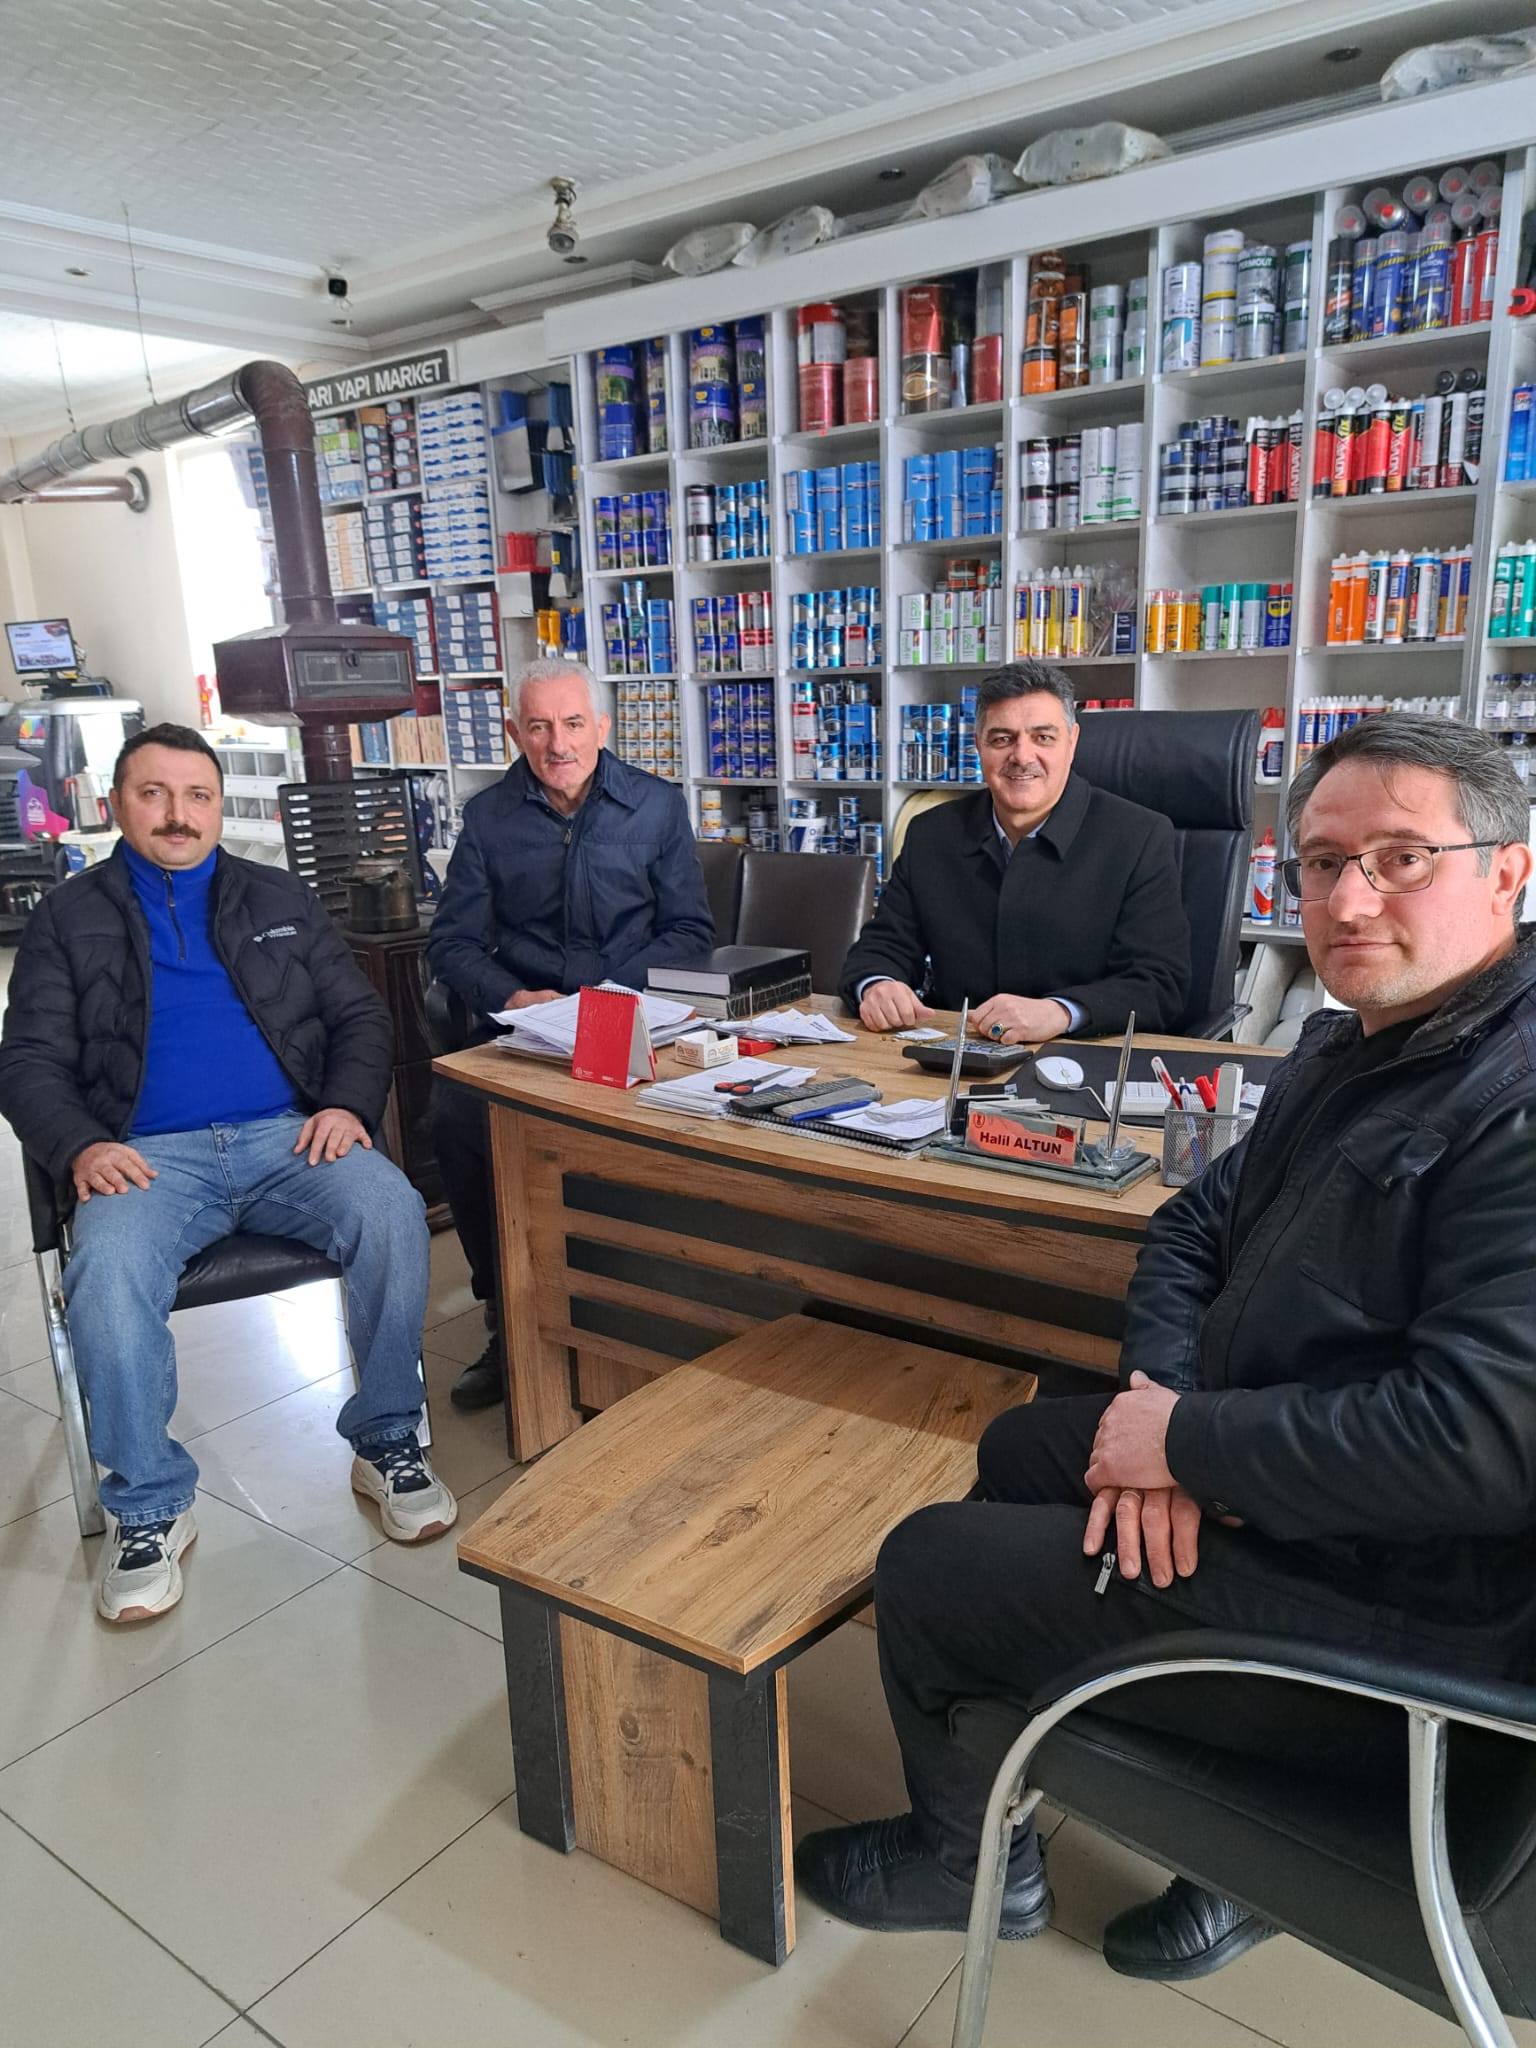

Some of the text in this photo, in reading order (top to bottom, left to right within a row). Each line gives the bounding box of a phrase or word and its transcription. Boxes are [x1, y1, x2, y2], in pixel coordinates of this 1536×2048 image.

[307, 357, 443, 408] ARI YAPI MARKET
[979, 1131, 1062, 1155] Halil ALTUN
